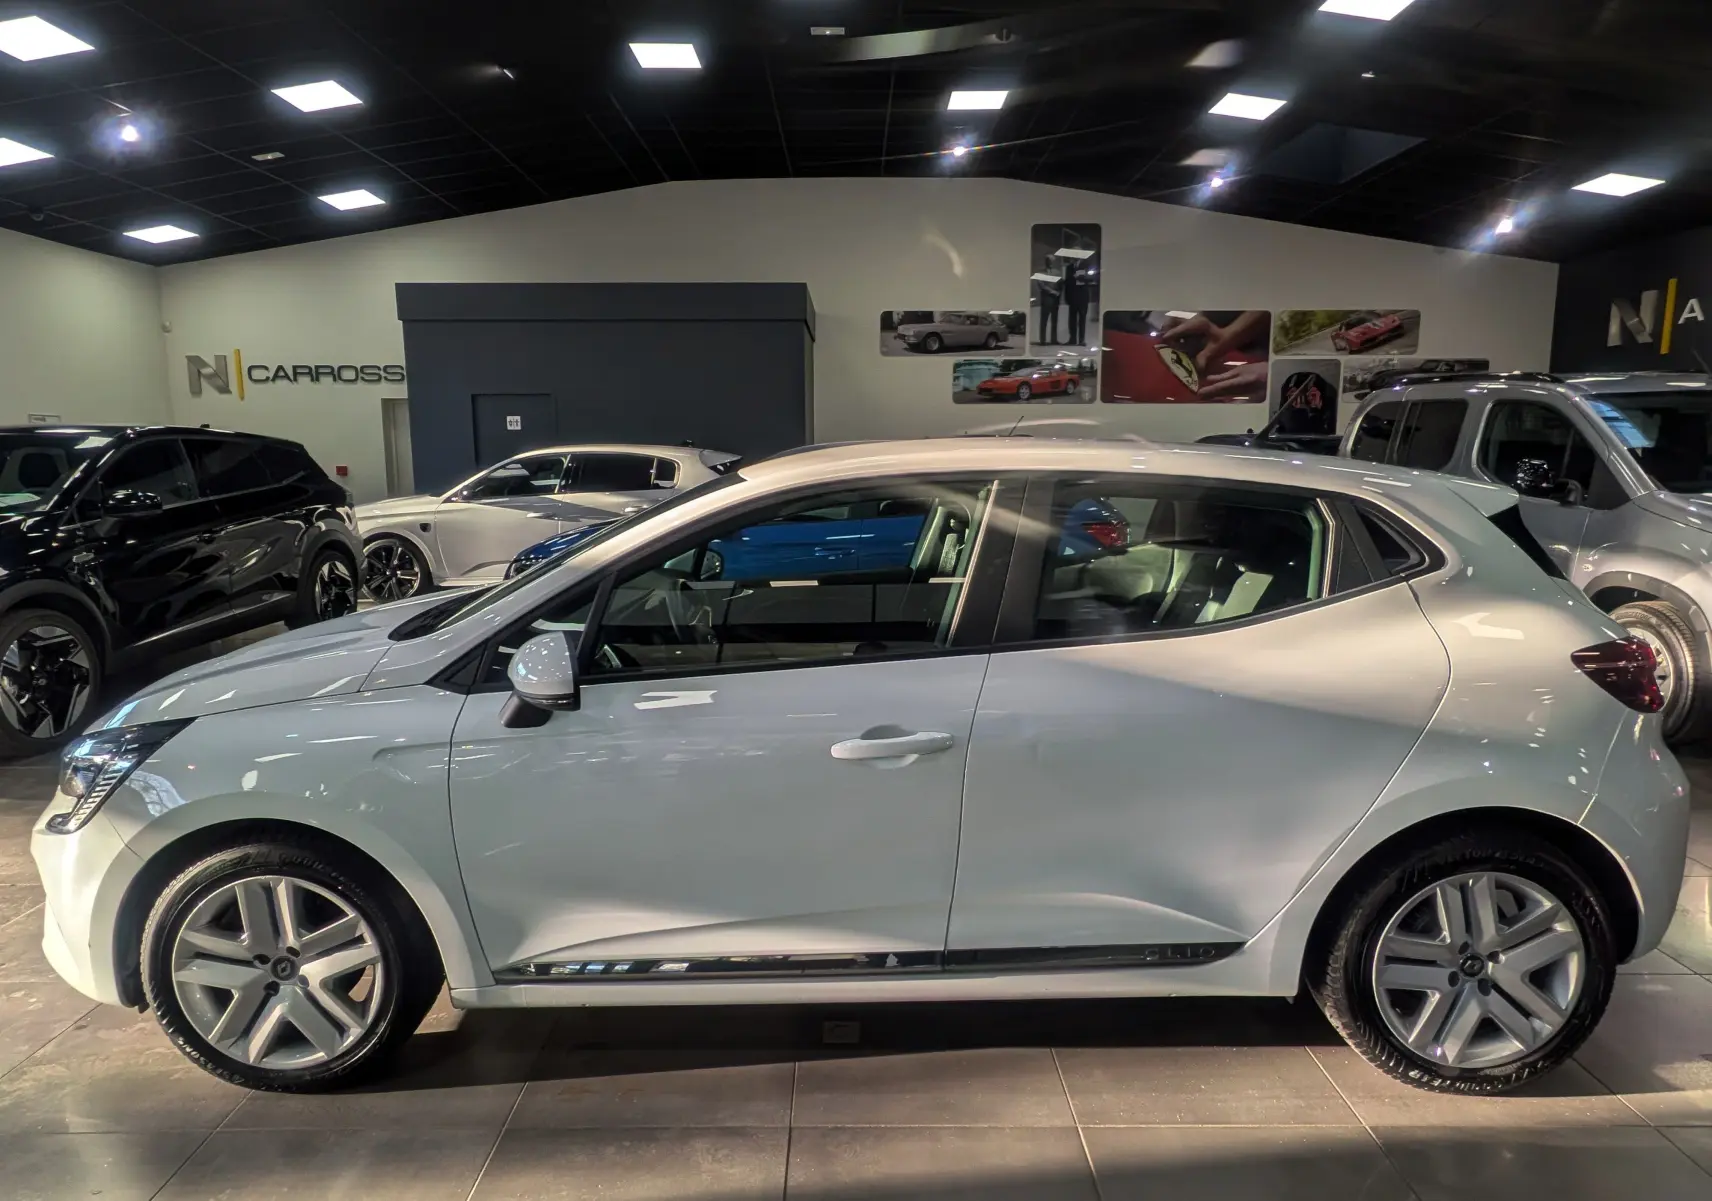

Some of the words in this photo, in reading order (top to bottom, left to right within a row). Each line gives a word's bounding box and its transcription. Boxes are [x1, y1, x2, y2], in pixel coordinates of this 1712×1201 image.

[1678, 298, 1705, 325] A
[185, 354, 232, 397] N
[247, 364, 405, 384] CARROSS
[1145, 946, 1215, 960] CLIO
